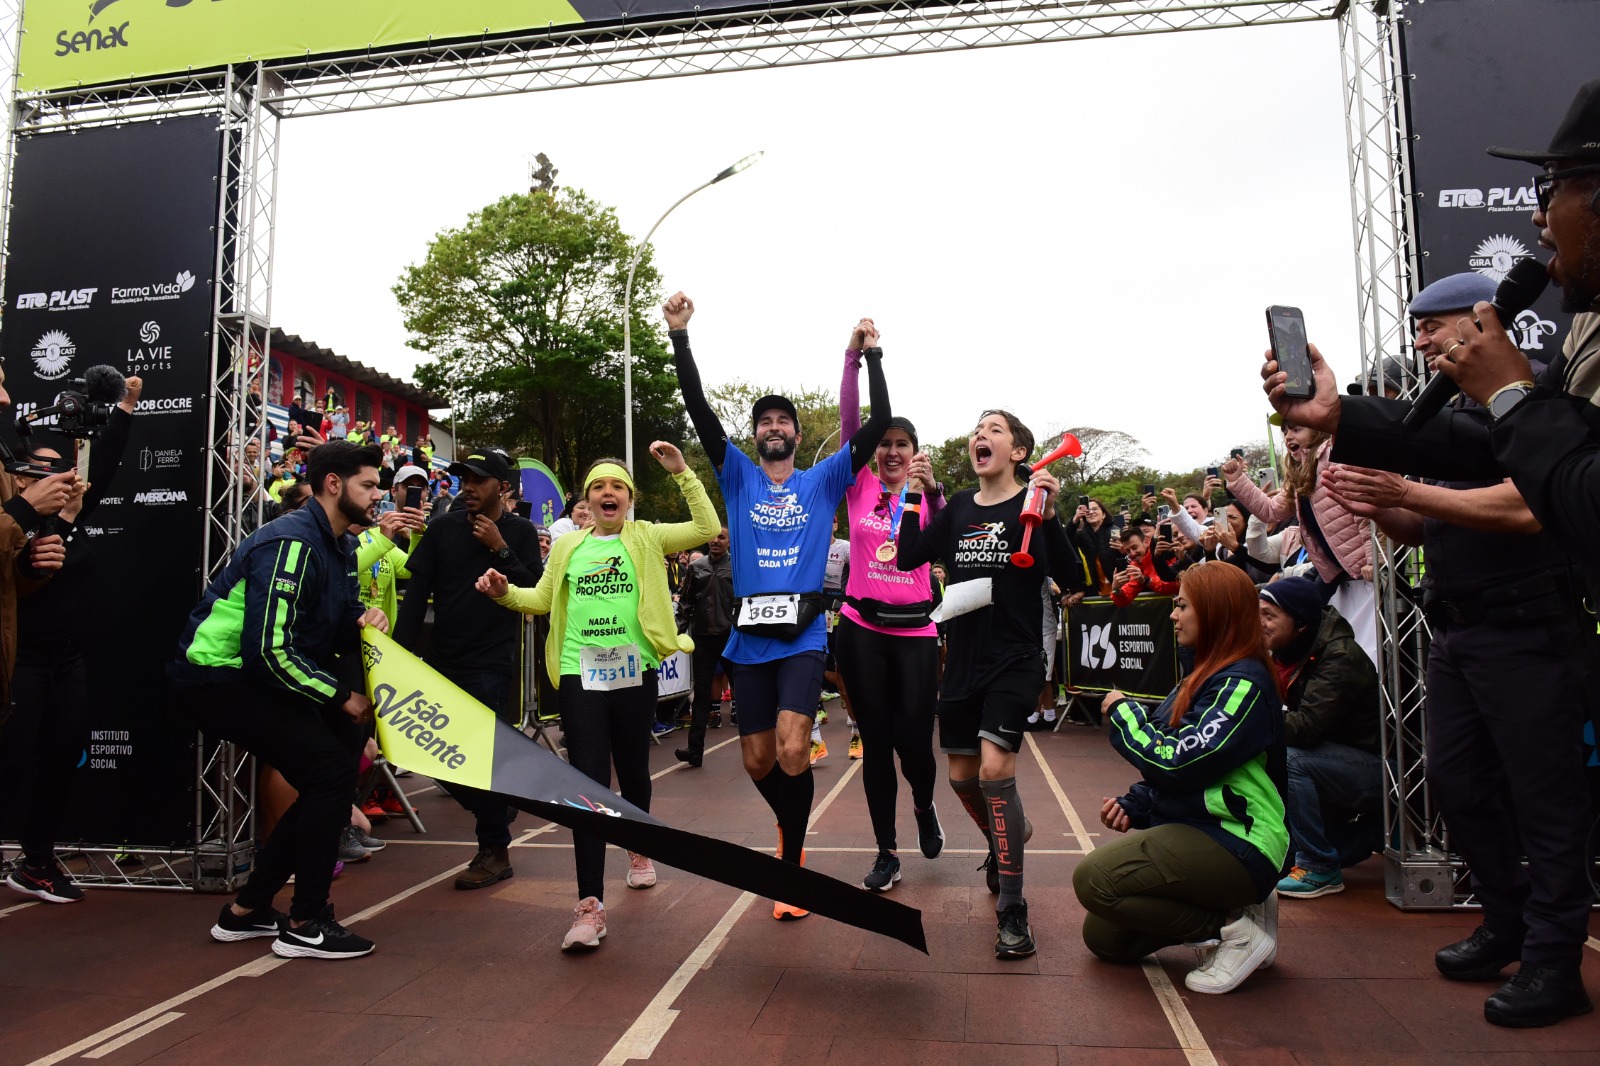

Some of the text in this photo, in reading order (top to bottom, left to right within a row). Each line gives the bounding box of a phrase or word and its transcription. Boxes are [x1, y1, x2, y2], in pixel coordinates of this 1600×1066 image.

[1487, 187, 1538, 206] PLAS
[1469, 258, 1491, 267] GIRA
[49, 288, 98, 307] PLAST
[111, 283, 181, 299] Farma Vida
[60, 347, 77, 355] CAST
[127, 346, 172, 362] LA VIE
[126, 361, 172, 375] sports
[156, 397, 192, 410] COCRE
[154, 449, 183, 457] DANIELA
[157, 456, 180, 464] FERRO
[133, 490, 188, 503] AMERICANA
[754, 503, 803, 517] PROJETO
[757, 545, 800, 557] UM DIA DE
[958, 539, 1009, 550] PROJETO
[758, 556, 798, 568] CADA VEZ
[577, 572, 628, 586] PROJETO
[867, 571, 914, 585] CONQUISTAS
[575, 582, 634, 597] PROPÓSITO
[747, 605, 788, 620] 365
[588, 614, 618, 626] NADA É
[581, 626, 627, 637] IMPOSSÍVEL
[1118, 623, 1151, 636] INSTITUTO
[1119, 640, 1155, 653] ESPORTIVO
[1120, 657, 1144, 670] SOCIAL
[587, 665, 626, 681] 7531
[407, 695, 450, 731] são
[91, 730, 130, 741] INSTITUTO
[389, 709, 467, 770] vicente
[90, 744, 133, 755] ESPORTIVO
[90, 758, 118, 769] SOCIAL
